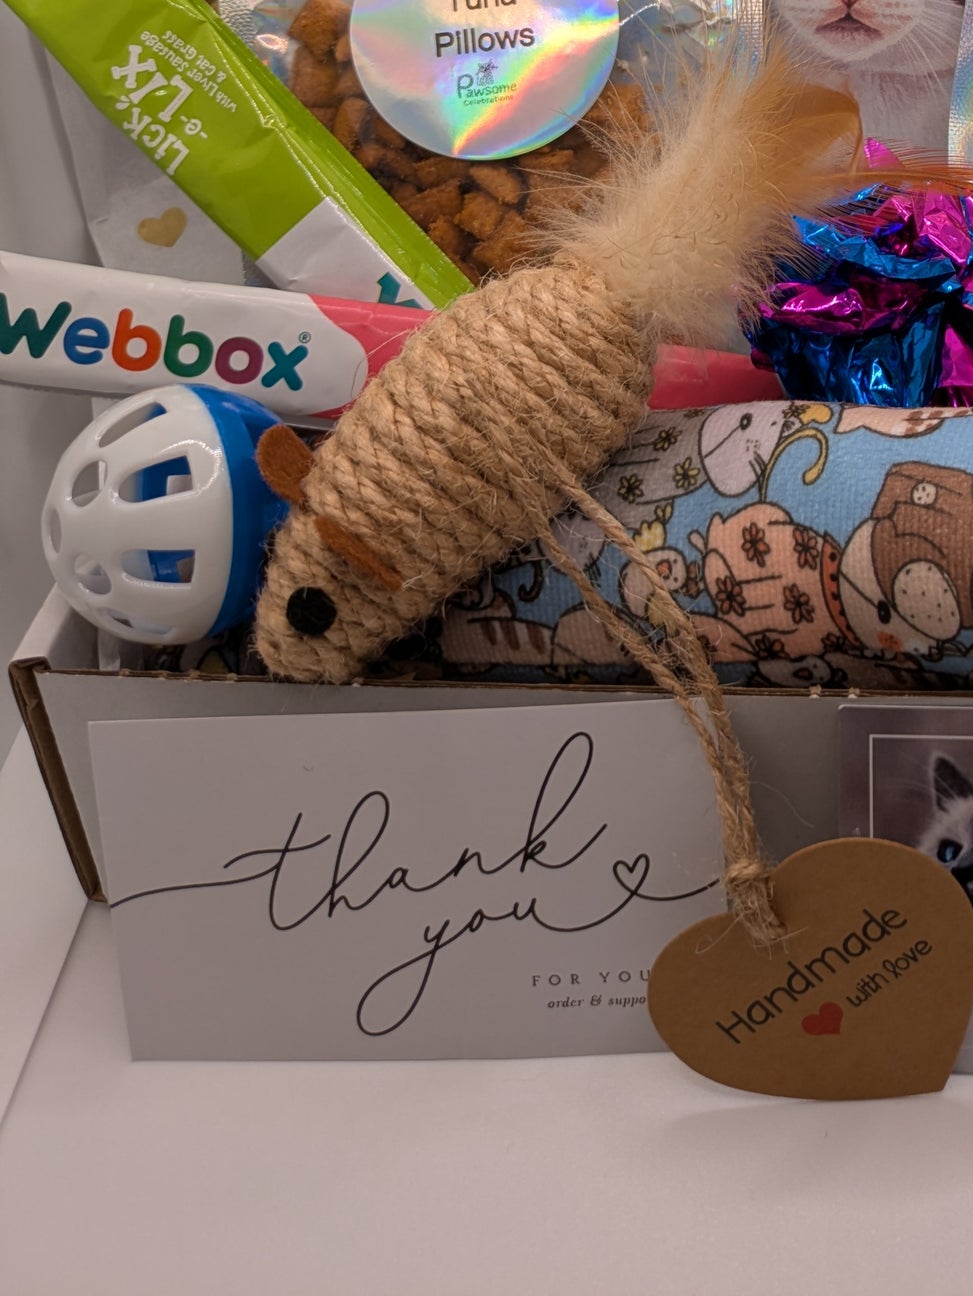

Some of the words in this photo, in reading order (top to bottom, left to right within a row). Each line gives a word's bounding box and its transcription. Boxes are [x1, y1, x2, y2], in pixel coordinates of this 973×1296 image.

[140, 31, 189, 73] Sausage
[162, 30, 197, 60] Grass
[434, 27, 536, 58] Pillows
[195, 55, 217, 76] Cat
[216, 72, 227, 83] &
[187, 68, 219, 97] Liver
[456, 74, 518, 100] Pawsome
[217, 92, 238, 112] with
[111, 732, 607, 931] thank
[357, 897, 560, 1036] you
[532, 973, 580, 987] FOR
[599, 969, 651, 983] YOU
[715, 908, 908, 1044] Handmade
[846, 970, 890, 1008] with
[882, 939, 933, 978] love
[547, 996, 584, 1008] order
[608, 994, 647, 1008] suppo
